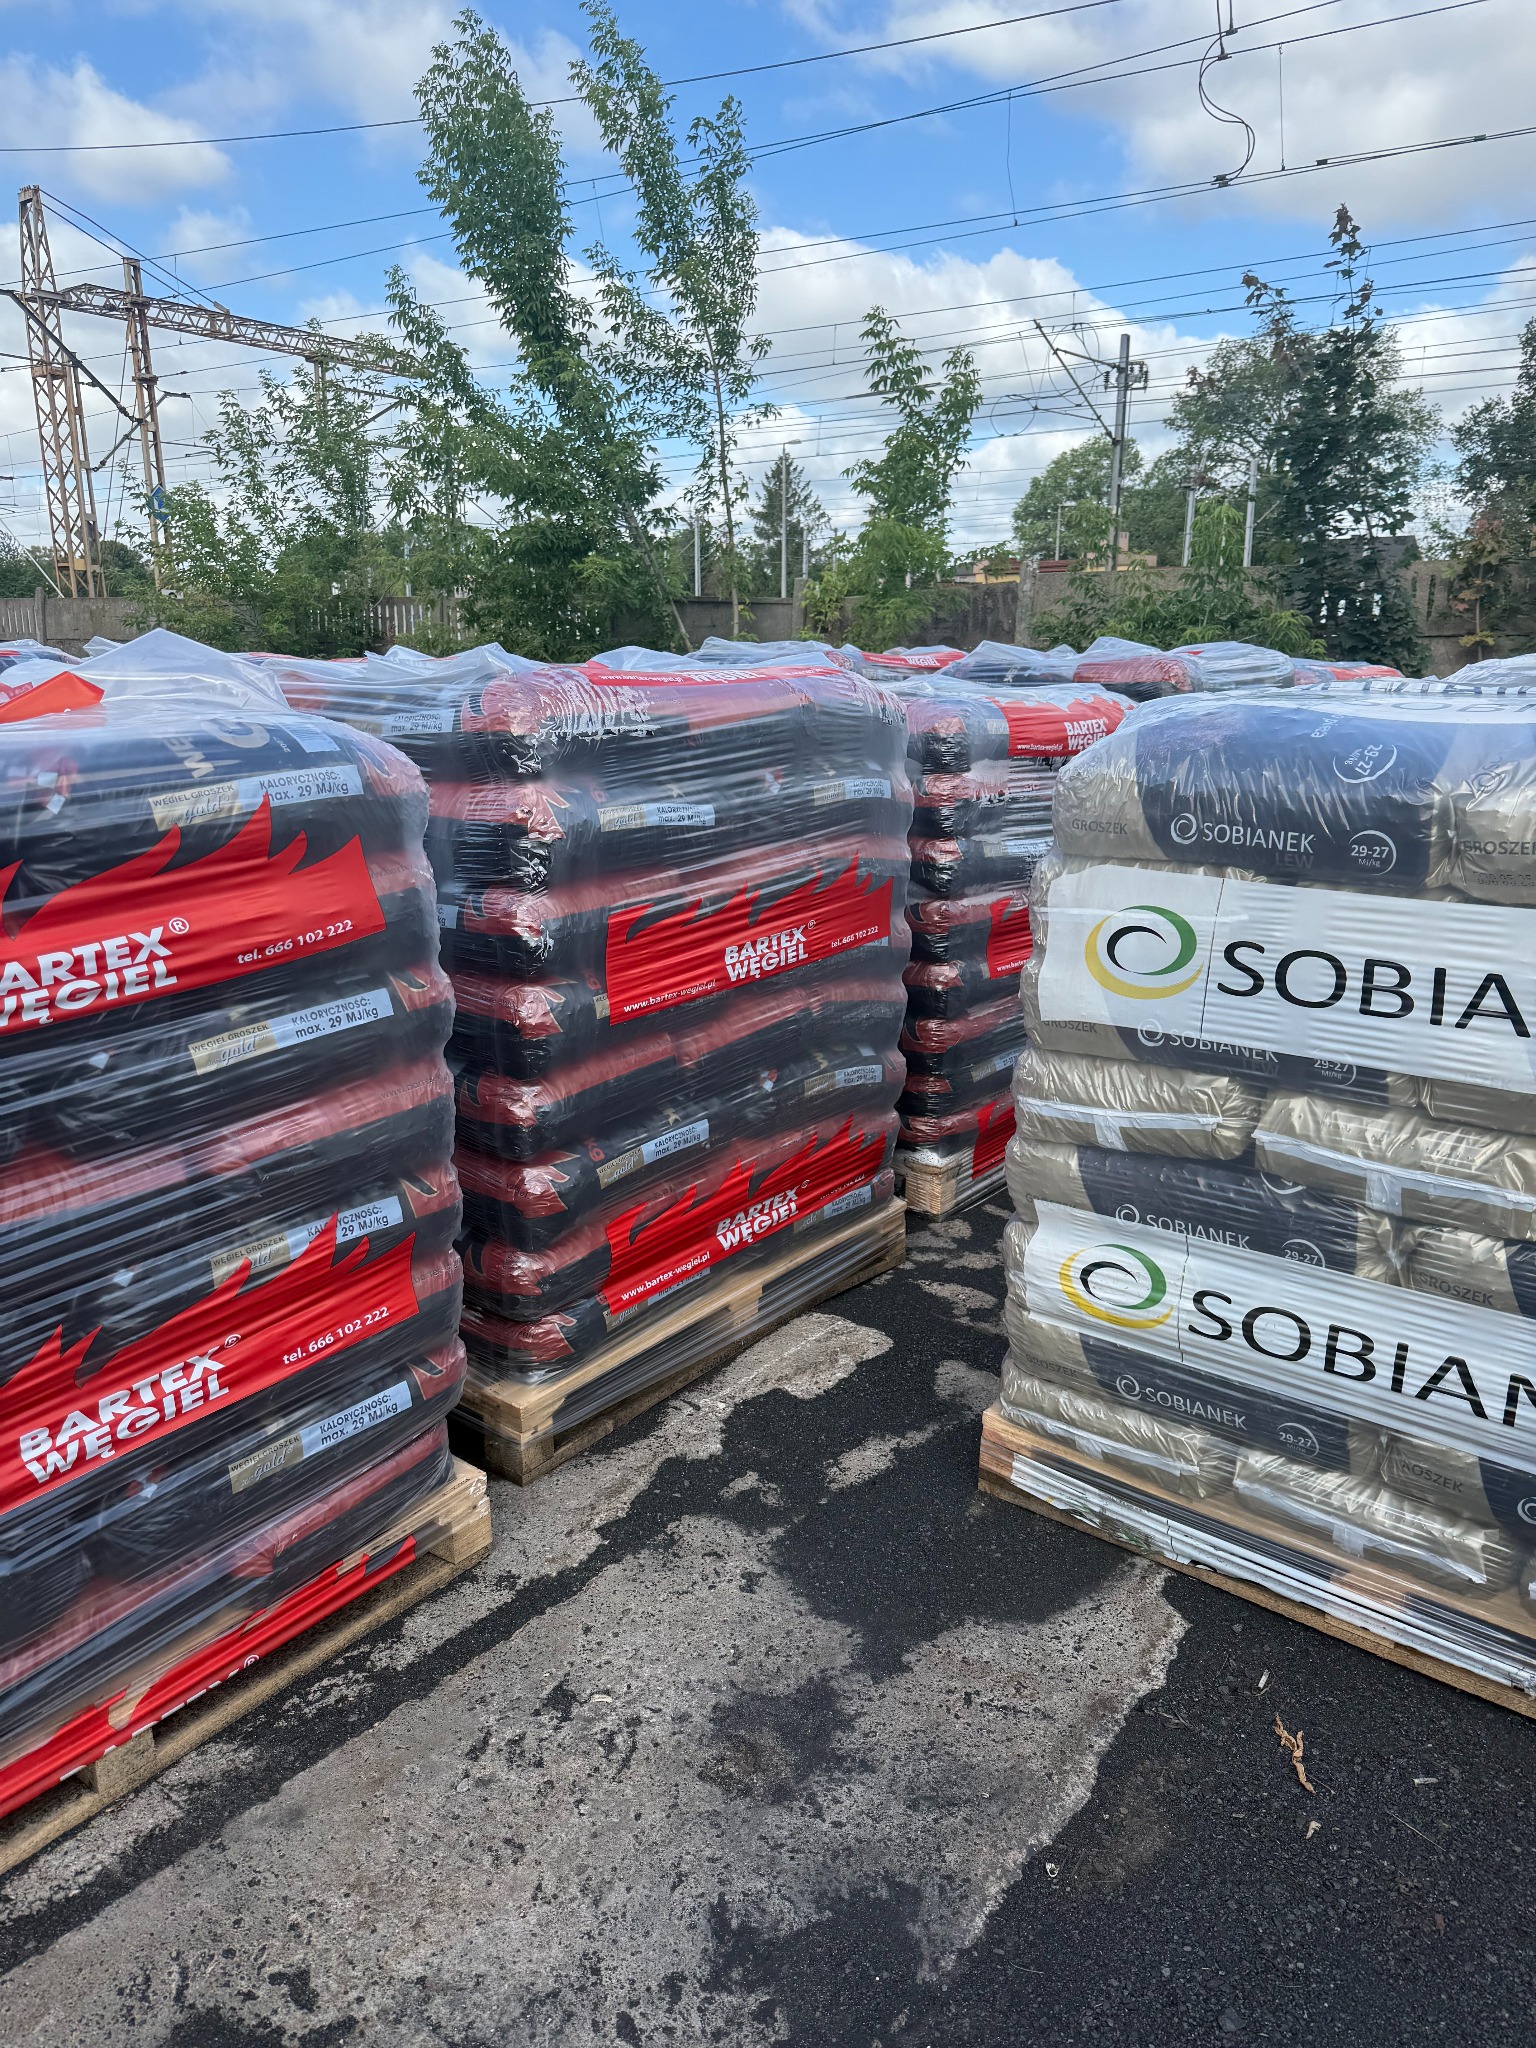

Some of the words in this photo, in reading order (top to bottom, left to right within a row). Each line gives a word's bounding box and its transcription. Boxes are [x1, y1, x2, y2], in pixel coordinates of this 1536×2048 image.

[1064, 718, 1108, 736] BARTEX
[1354, 743, 1384, 776] 29-27
[153, 795, 190, 807] WĘGIEL
[190, 784, 235, 799] GROSZEK
[259, 769, 341, 790] KALORYCZNOŚĆ:
[298, 784, 312, 798] 29
[316, 782, 349, 795] MJ/kg
[1071, 818, 1128, 835] GROSZEK
[1202, 822, 1314, 854] SOBIANEK
[1350, 844, 1390, 858] 29-27
[237, 948, 262, 964] tel.
[265, 938, 294, 957] 666
[298, 929, 324, 946] 102
[326, 918, 354, 938] 222
[831, 938, 842, 949] tel.
[842, 934, 855, 944] 666
[867, 925, 879, 936] 222
[725, 944, 809, 982] WĘGIEL
[623, 978, 717, 1013] www.bartex-wegiel.pl
[1217, 940, 1531, 1038] SOBIA
[291, 996, 372, 1027] KALORYCZNOŚĆ:
[295, 1022, 326, 1039] max.
[328, 1007, 342, 1029] 29
[346, 1007, 379, 1024] MJ/kg
[191, 1036, 227, 1053] WĘGIEL
[227, 1023, 269, 1041] GROSZEK
[1313, 1057, 1349, 1072] 29-27
[655, 1145, 672, 1158] max.
[716, 1184, 801, 1236] BARTEX
[716, 1201, 799, 1251] WĘGIEL
[341, 1225, 355, 1238] 29
[358, 1215, 389, 1232] MJ/kg
[212, 1250, 246, 1267] WĘGIEL
[245, 1235, 285, 1254] GROSZEK
[1284, 1249, 1319, 1265] 29-27
[620, 1250, 711, 1301] www.bartex-wegiel.pl
[1418, 1271, 1494, 1306] GROSZEK
[282, 1347, 307, 1365] tel.
[308, 1332, 335, 1353] 666
[336, 1319, 363, 1338] 102
[364, 1306, 390, 1326] 222
[319, 1392, 392, 1434] KALORYCZNOŚĆ:
[321, 1427, 349, 1446] max.
[352, 1416, 365, 1431] 29
[368, 1402, 398, 1423] MJ/kg
[1145, 1387, 1247, 1431] SOBIANEK
[24, 1373, 230, 1484] WĘGIEL
[1279, 1430, 1313, 1449] 29-27
